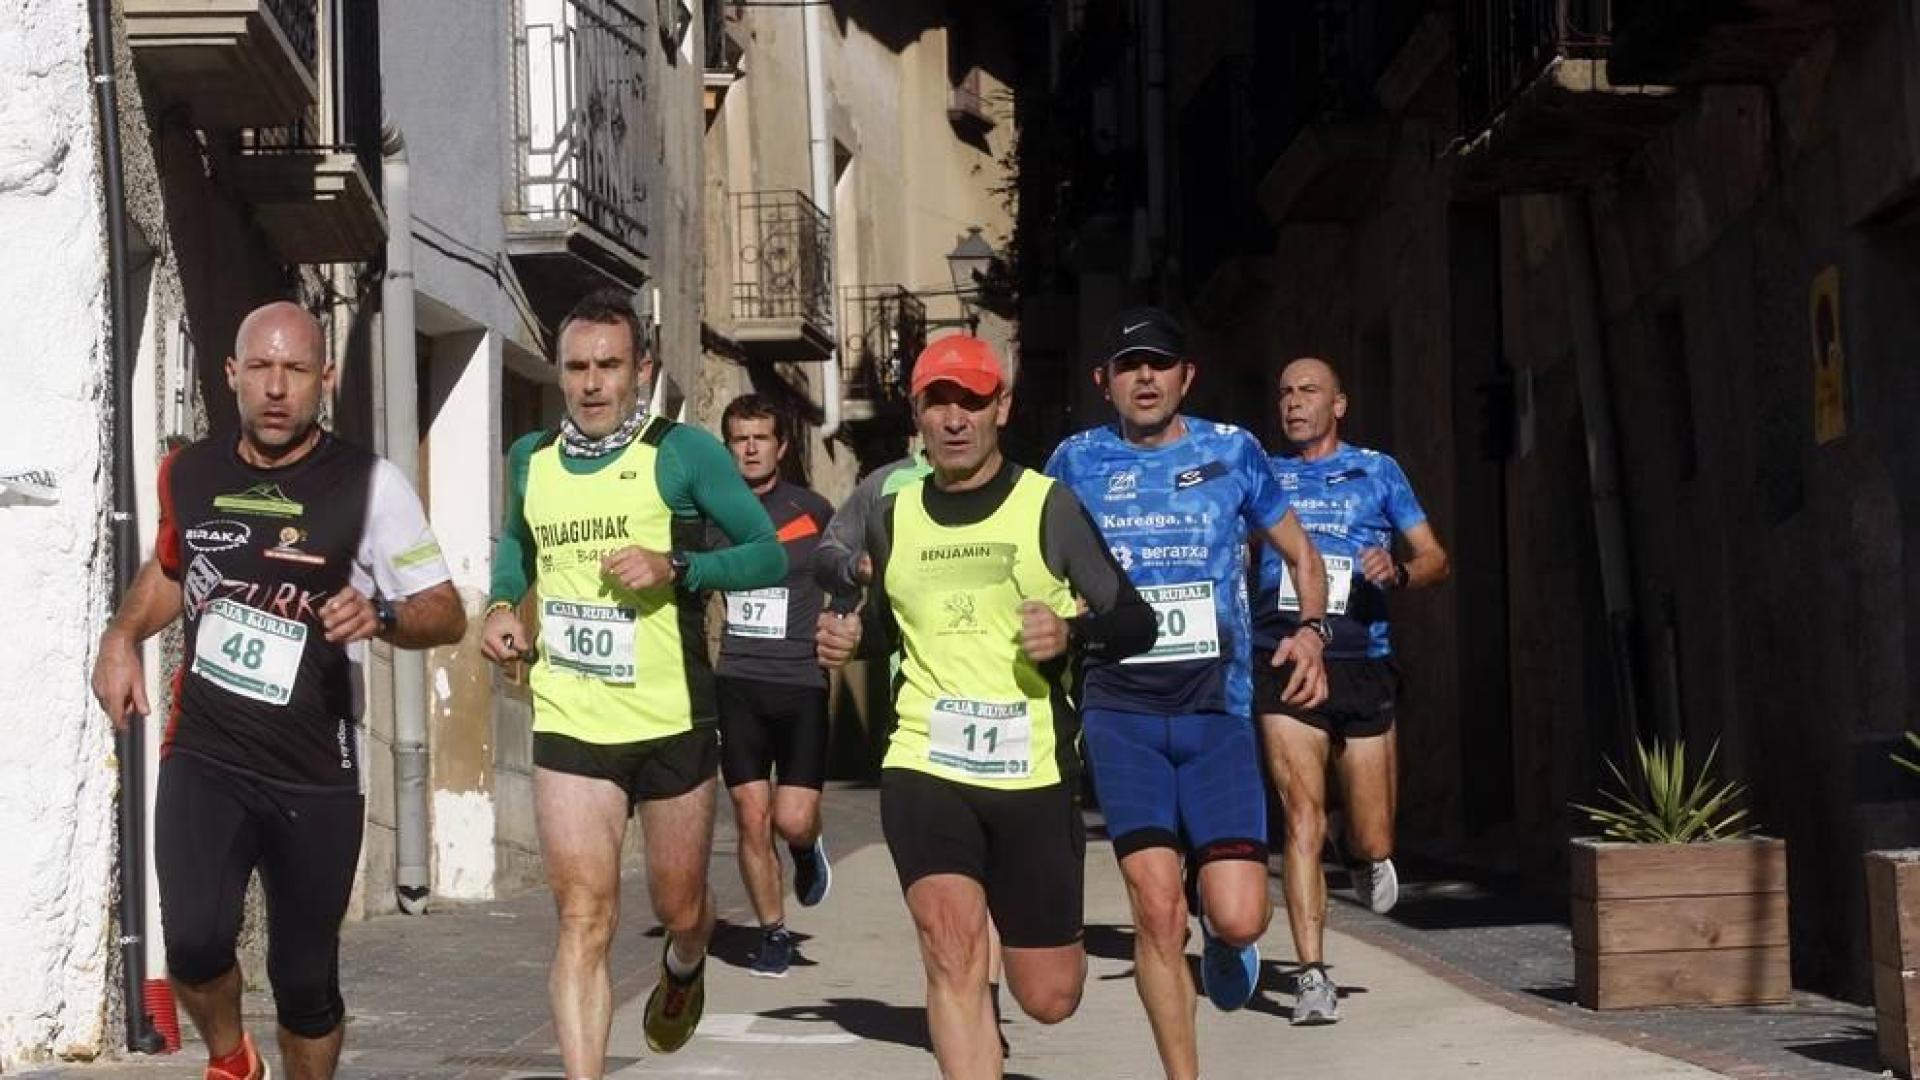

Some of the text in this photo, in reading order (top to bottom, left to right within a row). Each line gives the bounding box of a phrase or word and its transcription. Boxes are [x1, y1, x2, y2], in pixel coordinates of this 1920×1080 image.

[535, 515, 629, 549] TRILAGUNAK
[1102, 514, 1180, 528] Kareaga,
[921, 546, 990, 561] BENJAMIN
[1159, 586, 1208, 600] RURAL
[246, 609, 297, 640] RURAL
[743, 602, 767, 621] 97
[222, 632, 265, 669] 48
[564, 625, 614, 657] 160
[963, 724, 998, 753] 11
